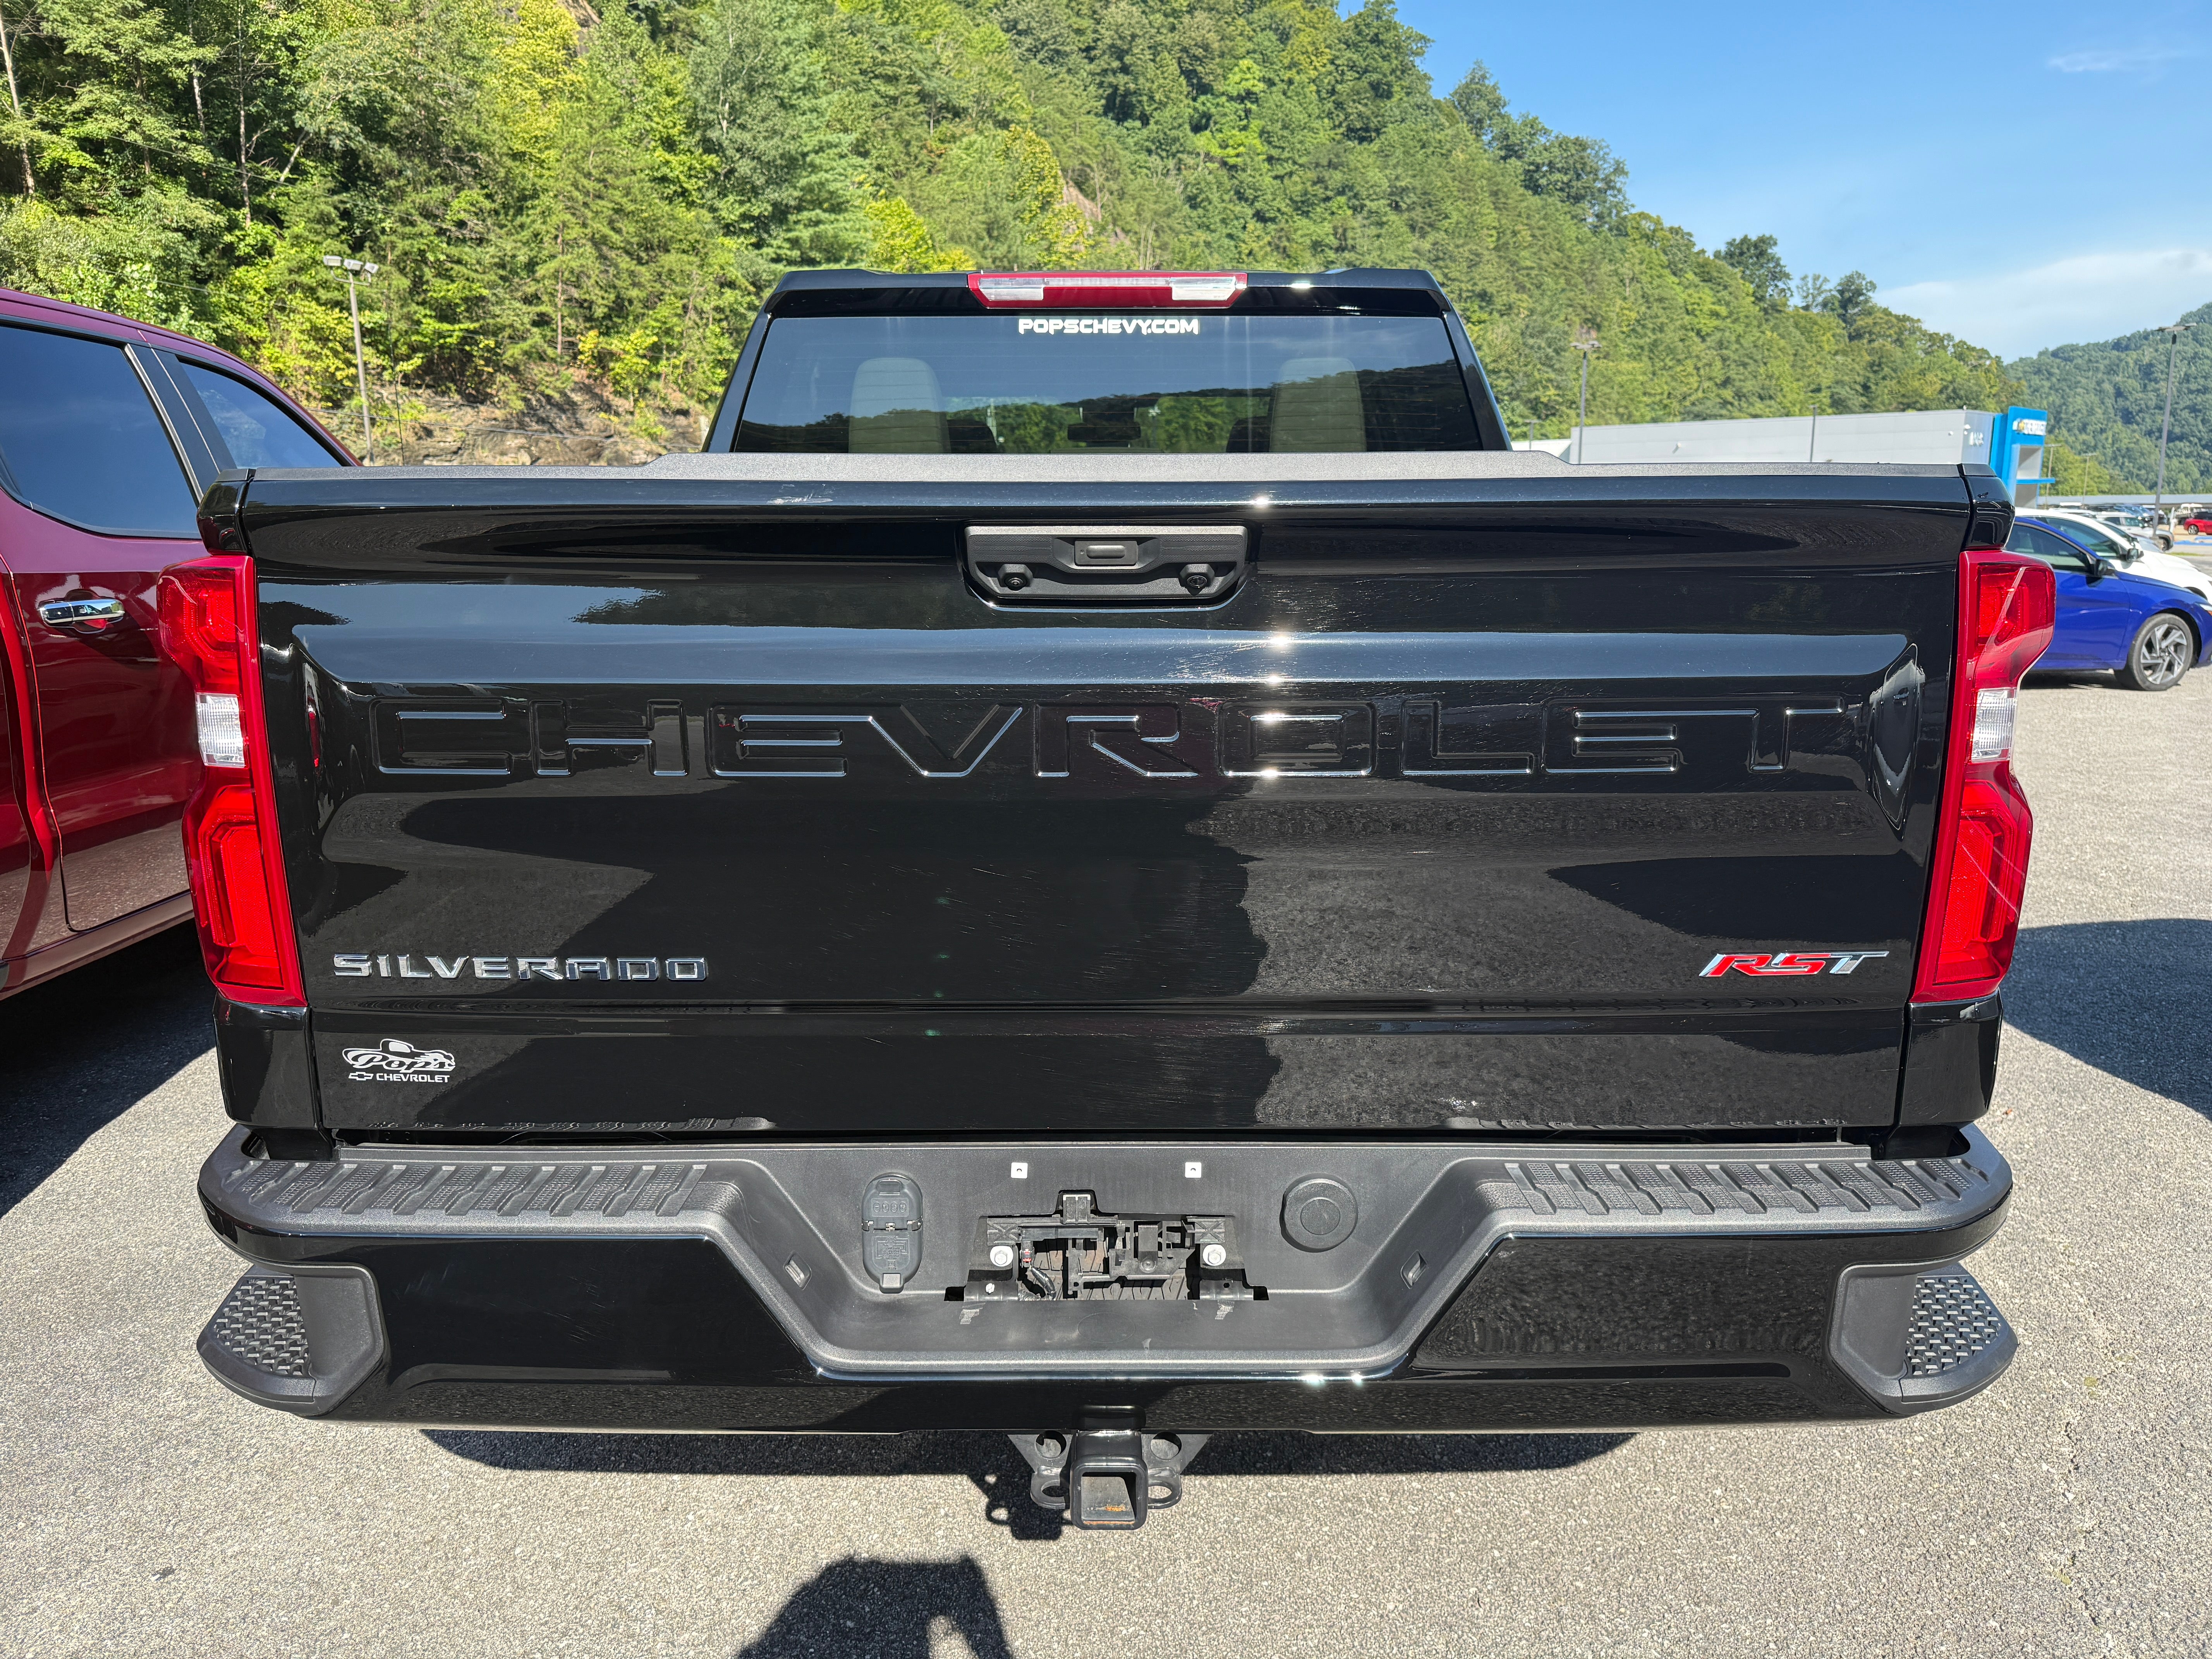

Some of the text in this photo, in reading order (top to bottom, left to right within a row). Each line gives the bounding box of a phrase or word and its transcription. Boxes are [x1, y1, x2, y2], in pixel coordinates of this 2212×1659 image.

[1018, 318, 1199, 335] POPSCHEVY.COM
[370, 692, 1845, 778] CHEVROLET
[333, 953, 708, 981] SILVERADO
[1698, 951, 1890, 977] RST
[376, 1073, 450, 1083] CHEVROLET
